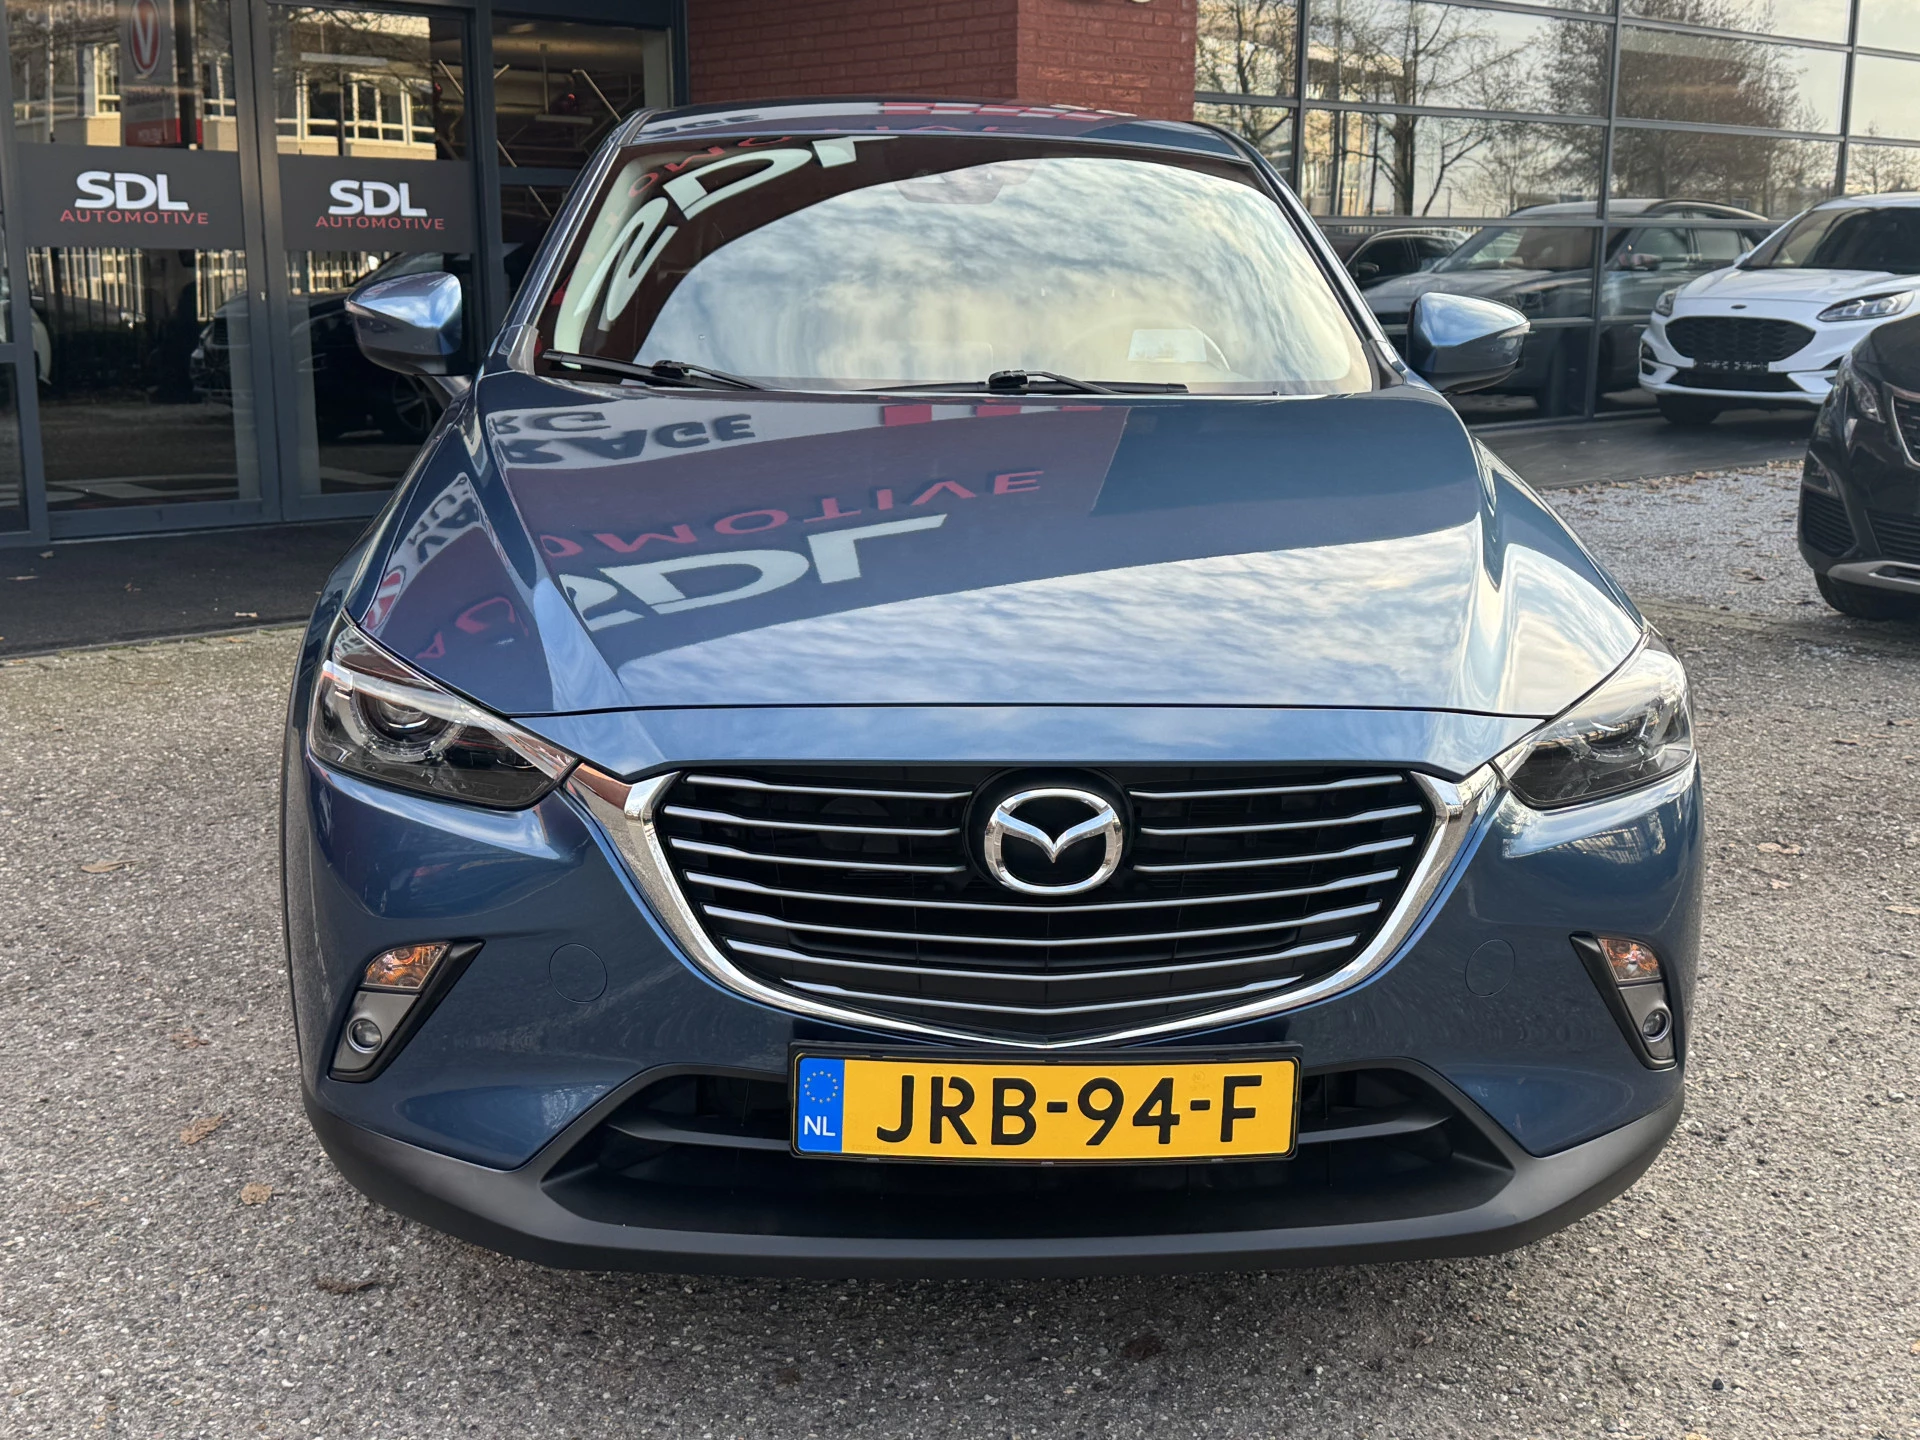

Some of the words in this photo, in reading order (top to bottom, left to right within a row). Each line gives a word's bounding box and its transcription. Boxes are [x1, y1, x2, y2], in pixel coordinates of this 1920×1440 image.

[74, 170, 190, 211] SDL
[328, 179, 428, 217] SDL
[60, 209, 209, 225] AUTOMOTIVE
[315, 216, 445, 230] AUTOMOTIVE
[876, 1074, 1263, 1146] JRB-94-F
[803, 1114, 836, 1137] NL
